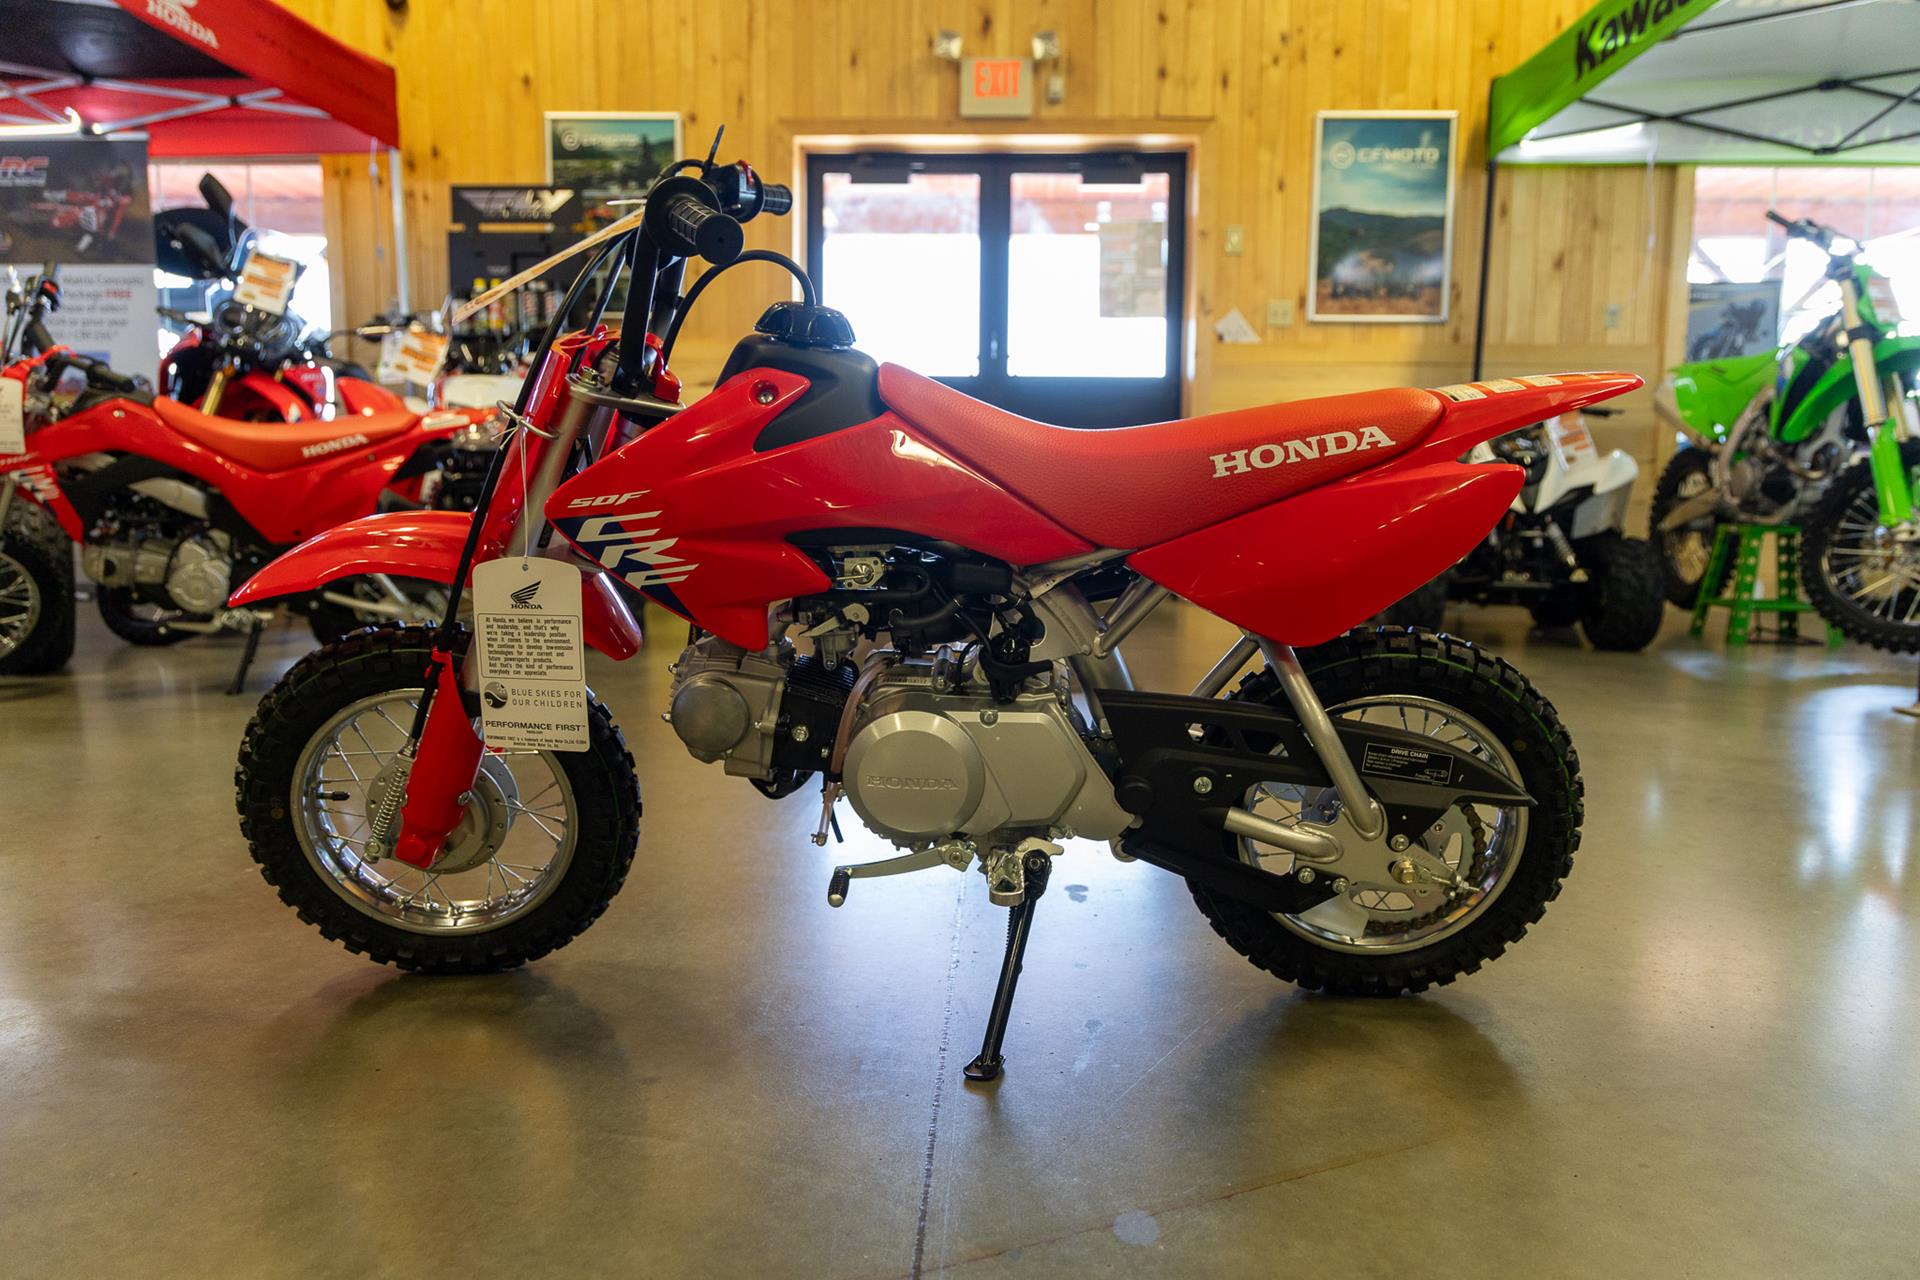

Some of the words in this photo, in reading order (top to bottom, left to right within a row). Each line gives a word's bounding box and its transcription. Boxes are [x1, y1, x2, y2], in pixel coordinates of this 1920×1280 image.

[974, 60, 1022, 97] EXIT
[1358, 147, 1440, 163] CFMOTO
[301, 433, 368, 458] HONDA
[1209, 425, 1396, 478] HONDA
[567, 489, 652, 508] 50F
[575, 510, 700, 590] CRF
[486, 721, 552, 730] PERFORMANCE
[1391, 748, 1408, 757] DRIVE
[1410, 751, 1428, 760] CHAIN
[864, 776, 960, 790] HONDA
